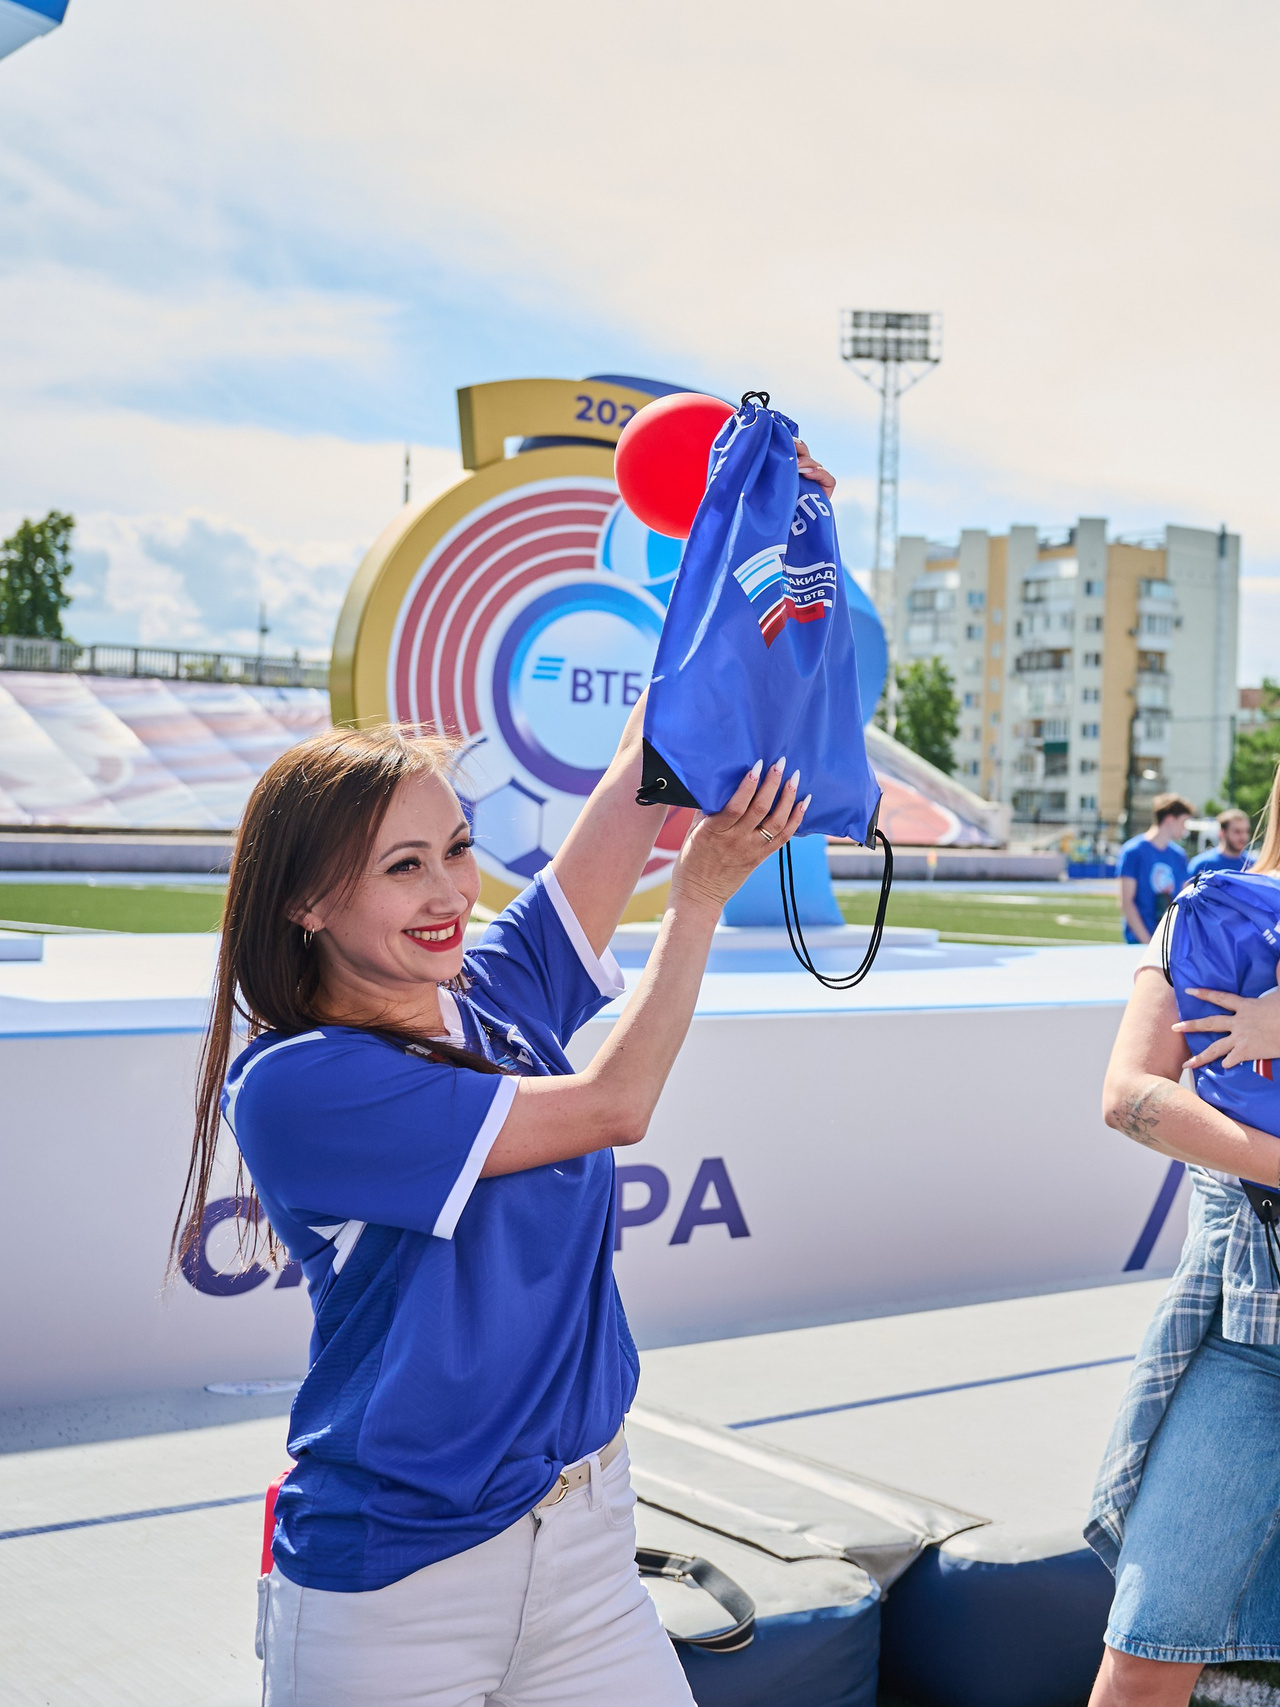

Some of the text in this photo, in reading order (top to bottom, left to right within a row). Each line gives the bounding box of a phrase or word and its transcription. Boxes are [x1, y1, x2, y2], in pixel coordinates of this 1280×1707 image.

[575, 395, 637, 428] 202
[791, 493, 831, 536] ВТБ
[804, 589, 825, 602] ВТБ
[571, 667, 643, 706] ВТБ
